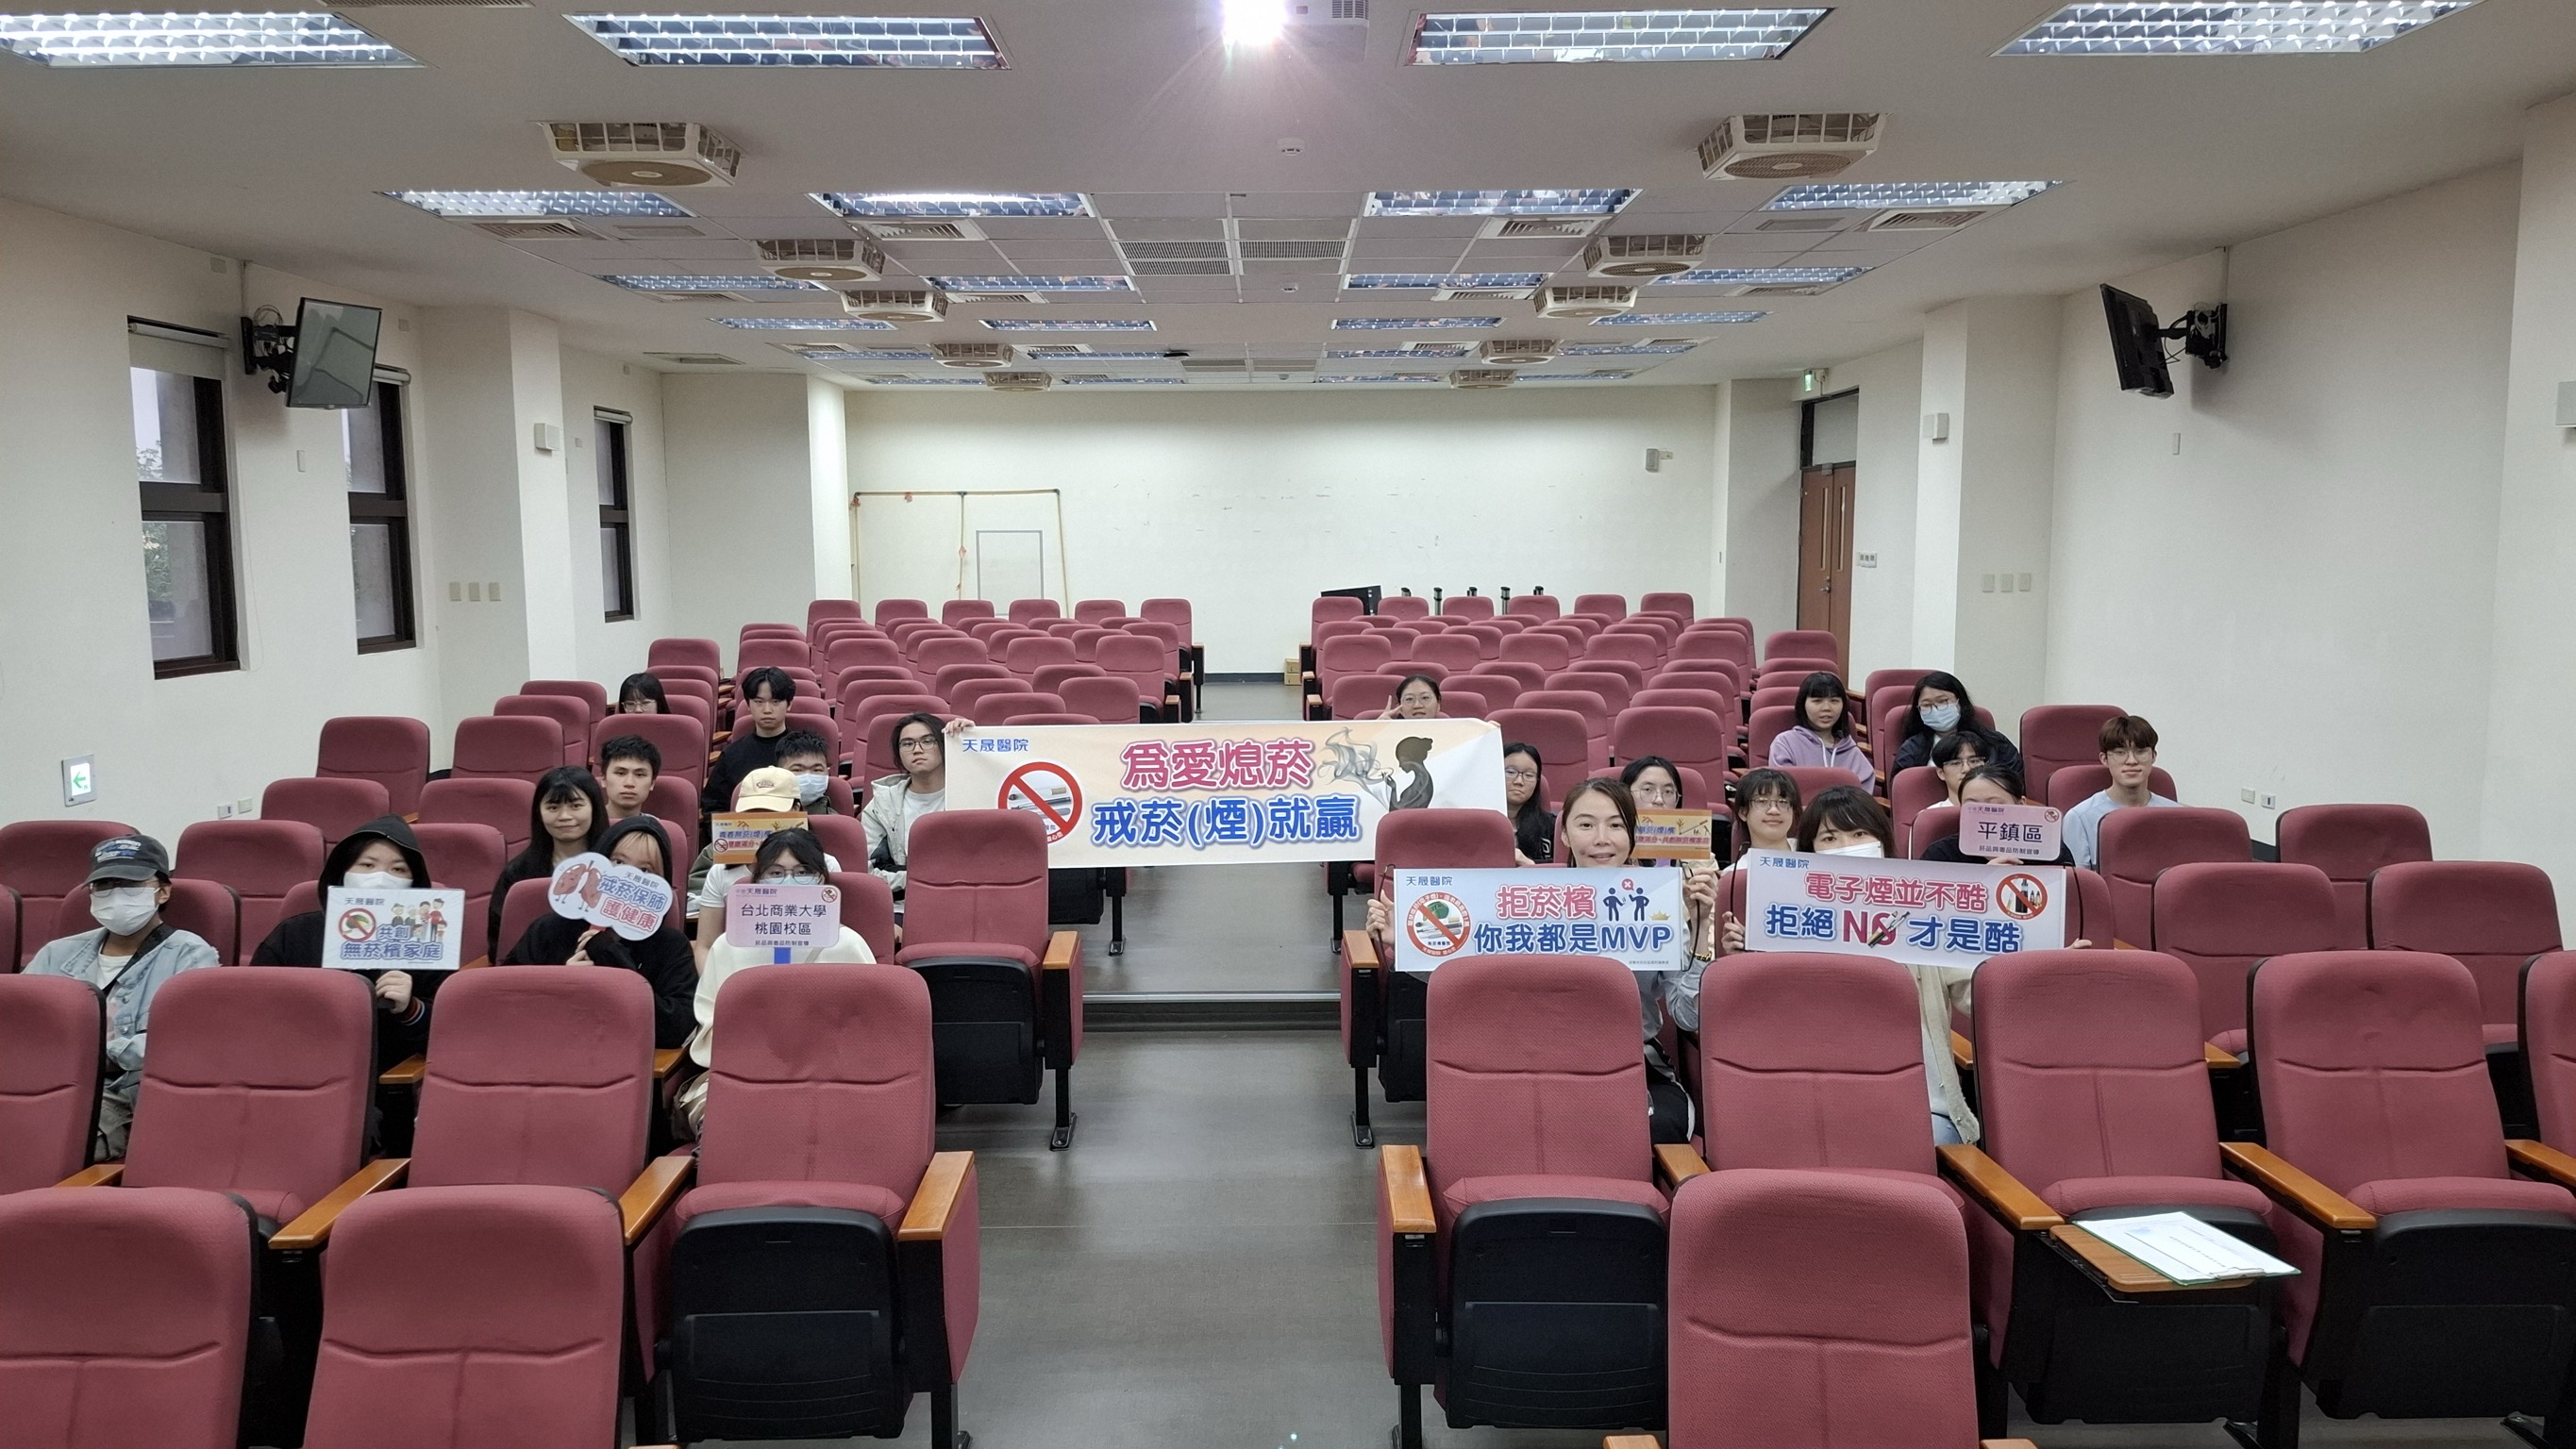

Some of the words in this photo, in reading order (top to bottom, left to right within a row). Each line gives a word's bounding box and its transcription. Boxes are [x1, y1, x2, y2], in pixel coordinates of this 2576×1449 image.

[962, 738, 1029, 753] 天晟醫院
[1093, 797, 1359, 846] 戒菸(煙)就贏
[1978, 822, 2043, 843] 平鎮區
[1760, 857, 1810, 869] 天晟醫院
[1406, 876, 1453, 886] 天晟醫院
[597, 876, 667, 912] 戒菸保肺
[1805, 872, 1986, 912] 電子煙並不酷
[344, 897, 385, 906] 天晟醫院
[1497, 886, 1595, 918] 拒菸檳
[602, 898, 659, 931] 護健康
[741, 903, 827, 917] 台北商業大學
[378, 925, 410, 940] 共創
[754, 922, 811, 935] 桃園校區
[1473, 923, 1672, 953] 你我都是MVP
[343, 942, 442, 958] 無菸檳家庭
